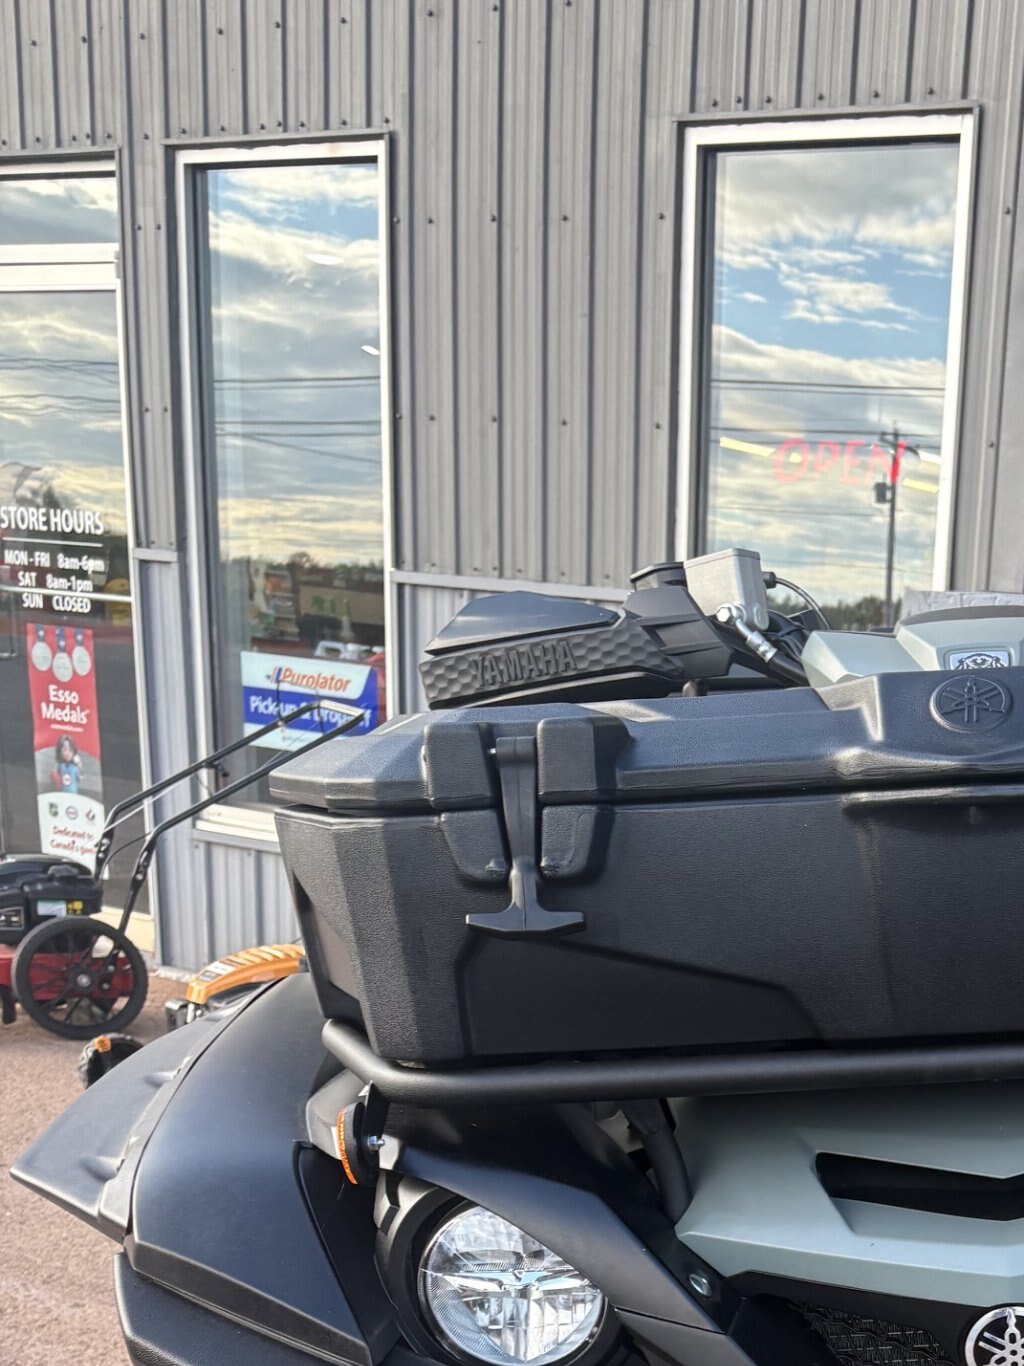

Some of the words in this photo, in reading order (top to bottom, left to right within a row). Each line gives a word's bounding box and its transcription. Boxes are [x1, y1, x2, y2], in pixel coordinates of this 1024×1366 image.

[773, 437, 907, 485] OPEN
[0, 506, 48, 531] STORE
[49, 508, 105, 535] HOURS
[57, 553, 105, 575] 8am-6pm
[17, 571, 37, 587] SAT
[46, 574, 94, 592] 8am-1pm
[22, 592, 43, 608] SUN
[52, 595, 91, 613] CLOSED
[472, 640, 578, 687] YAMAHA
[281, 667, 352, 693] Purolator
[48, 684, 79, 704] Esso
[41, 701, 88, 725] Medals
